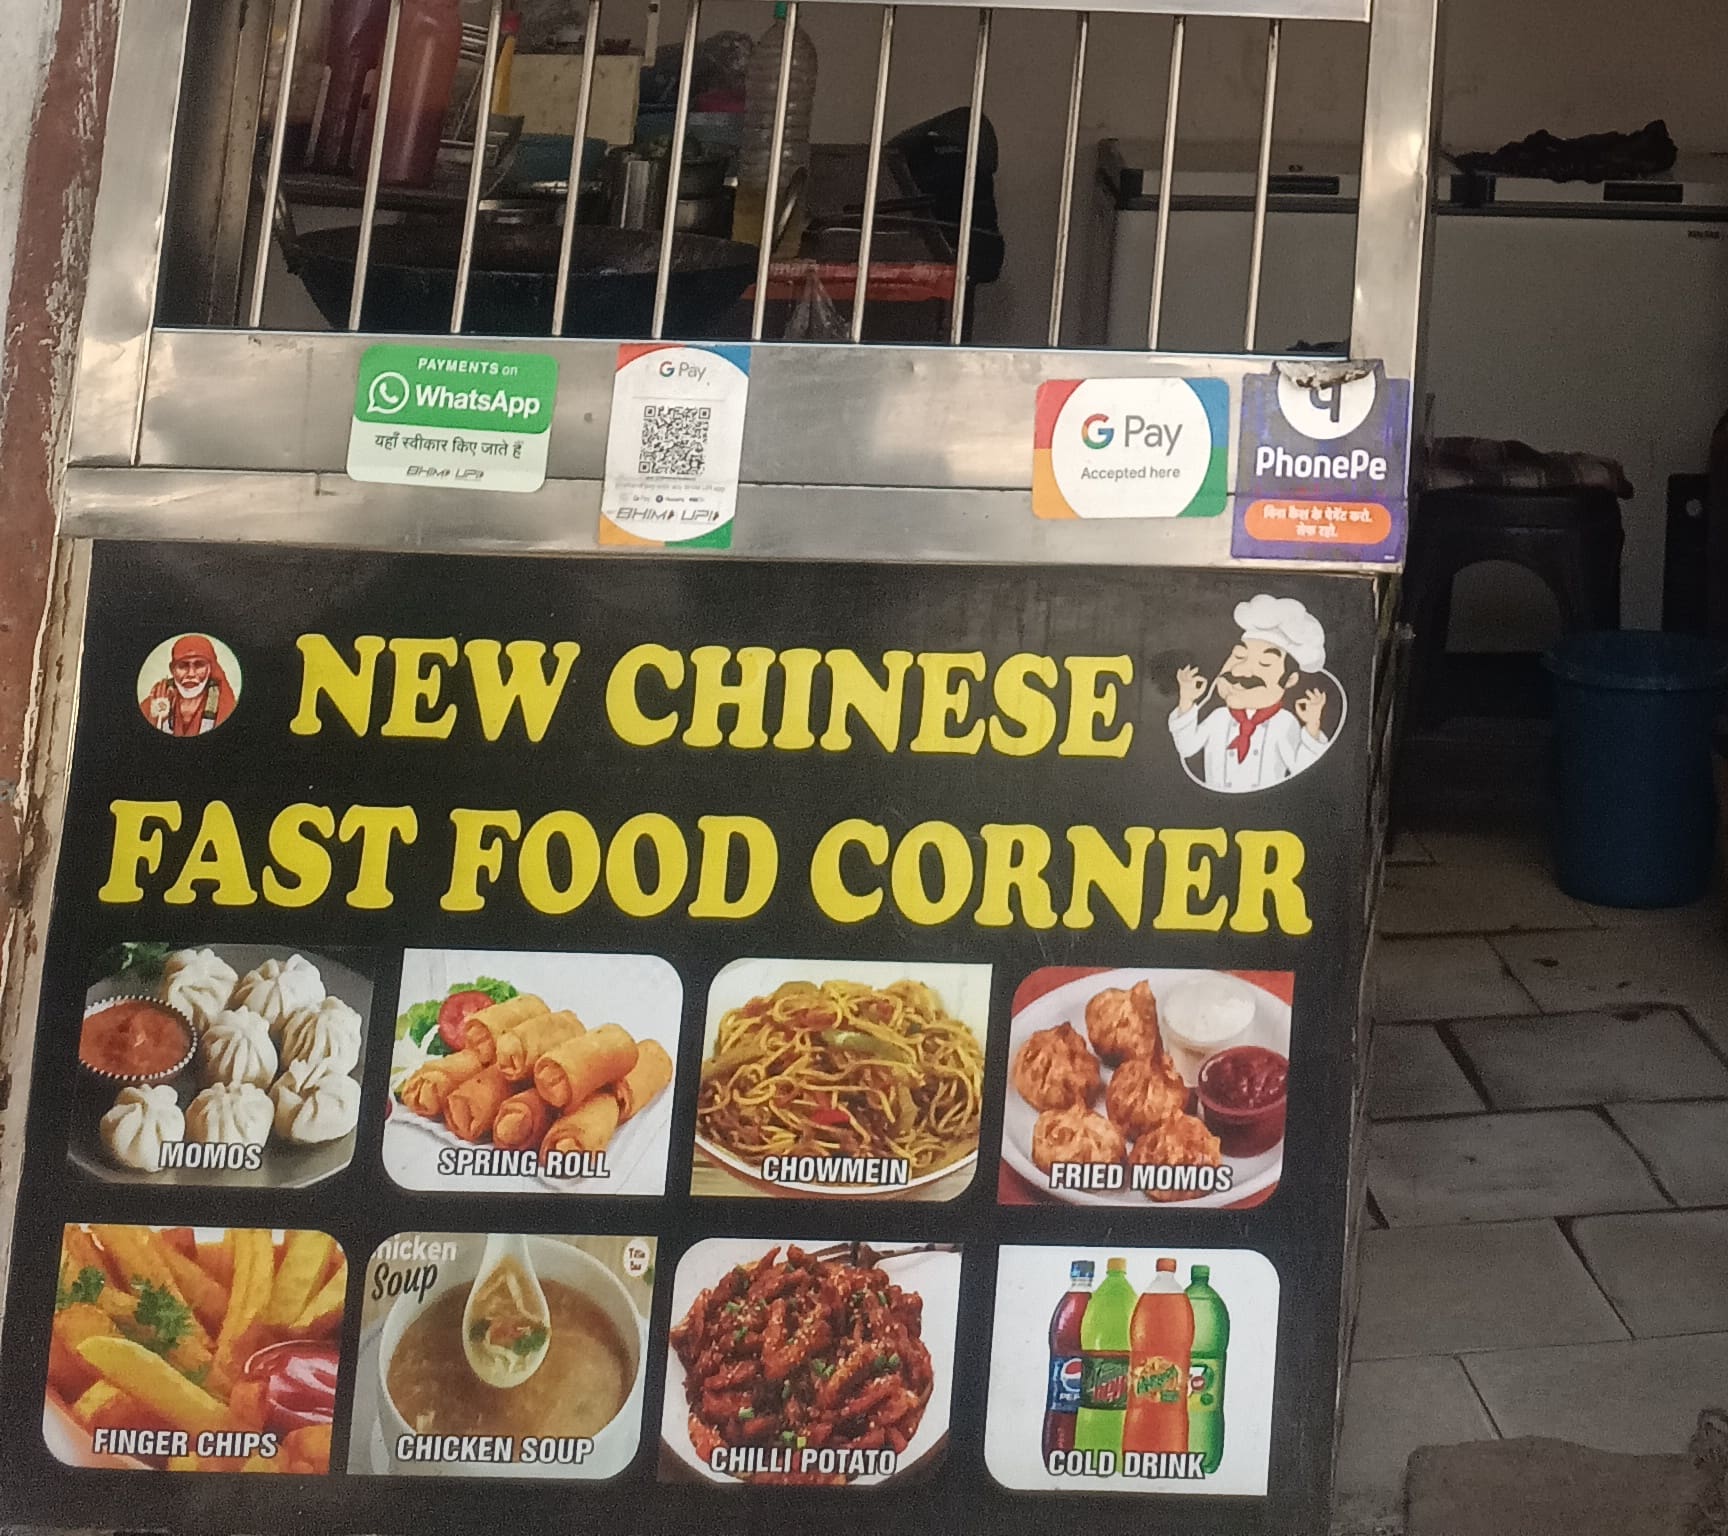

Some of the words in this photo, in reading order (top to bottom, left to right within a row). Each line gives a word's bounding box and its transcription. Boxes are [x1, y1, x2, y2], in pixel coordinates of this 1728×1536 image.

[418, 357, 499, 374] PAYMENTS
[501, 365, 518, 377] on
[678, 362, 706, 382] Pay
[415, 384, 540, 419] WhatsApp
[375, 431, 399, 451] यहाँ
[401, 433, 448, 453] स्वीकार
[452, 435, 478, 457] किए
[481, 439, 509, 457] जाते
[1124, 415, 1183, 457] Pay
[1080, 465, 1146, 483] Accepted
[1148, 464, 1181, 480] here
[1255, 446, 1388, 481] PhonePe
[289, 633, 581, 743] NEW
[605, 643, 1134, 759] CHINESE
[98, 799, 419, 910] FAST
[439, 808, 779, 919] FOOD
[810, 818, 1313, 936] CORNER
[158, 1141, 262, 1171] MOMOS
[437, 1149, 534, 1177] SPRING
[540, 1150, 609, 1179] ROLL
[760, 1155, 910, 1185] CHOWMEIN
[1048, 1160, 1128, 1190] FRIED
[1131, 1162, 1233, 1192] MOMOS
[371, 1263, 438, 1303] Soup
[93, 1428, 193, 1458] FINGER
[198, 1430, 278, 1460] CHIPS
[396, 1432, 515, 1463] CHICKEN
[520, 1434, 594, 1464] SOUP
[708, 1445, 794, 1474] CHILLI
[799, 1447, 898, 1476] POTATO
[1047, 1449, 1117, 1478] COLD
[1120, 1451, 1207, 1481] DRINK
